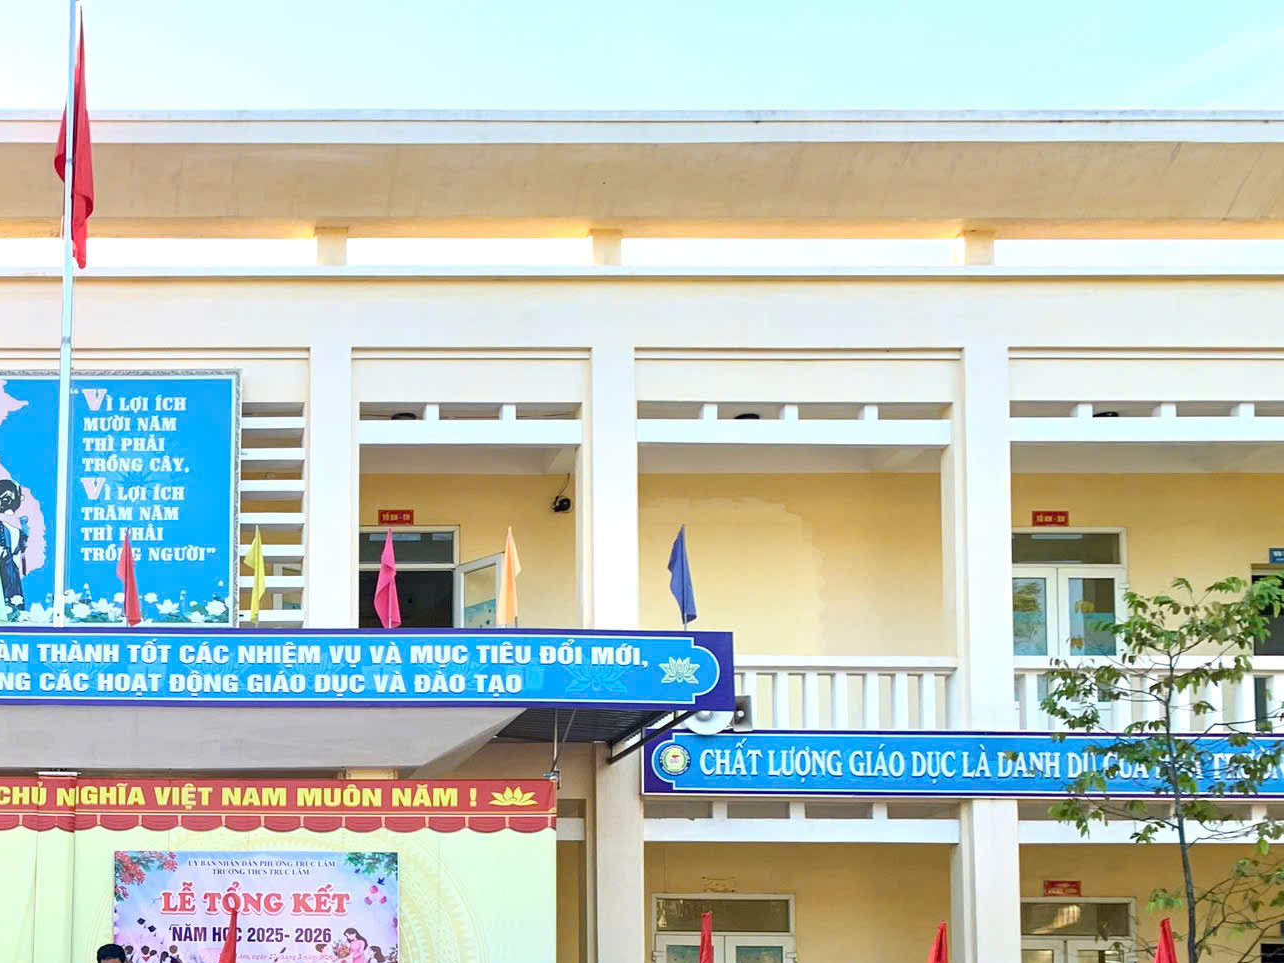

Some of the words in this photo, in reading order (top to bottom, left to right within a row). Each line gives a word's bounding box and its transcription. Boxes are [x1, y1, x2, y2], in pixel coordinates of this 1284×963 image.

[119, 395, 148, 413] LỢI
[155, 394, 186, 411] ÍCH
[83, 414, 131, 431] MƯỜI
[137, 415, 177, 431] NĂM
[82, 435, 114, 451] THÌ
[121, 434, 165, 451] PHẢI
[149, 455, 190, 472] CÂY,
[80, 477, 111, 500] VÌ
[117, 485, 147, 502] LỢI
[153, 483, 185, 500] ÍCH
[81, 504, 133, 520] TRĂM
[139, 504, 179, 520] NĂM
[81, 524, 113, 541] THÌ
[119, 523, 164, 541] PHẢI
[37, 641, 119, 662] THÀNH
[127, 638, 171, 664] TỐT
[179, 642, 229, 663] CÁC
[238, 642, 323, 667] NHIỆM
[329, 646, 361, 667] VỤ
[370, 642, 402, 664] VÀ
[410, 645, 468, 668] MỤC
[476, 641, 531, 664] TIÊU
[540, 639, 582, 665] ĐỔI
[591, 645, 648, 668] MỚI,
[39, 670, 89, 692] CÁC
[98, 674, 162, 696] HOẠT
[169, 670, 238, 696] ĐỘNG
[247, 672, 306, 693] GIÁO
[315, 674, 364, 697] DỤC
[373, 672, 406, 693] VÀ
[414, 671, 466, 693] ĐÀO
[473, 675, 523, 697] TẠO
[700, 739, 762, 775] CHẤT
[768, 747, 842, 782] LƯỢNG
[849, 744, 905, 777] GIÁO
[912, 751, 956, 784] DỤC
[962, 744, 992, 778] LÀ
[997, 751, 1061, 778] DANH
[56, 783, 146, 806] NGHĨA
[154, 783, 212, 809] VIỆT
[222, 787, 287, 806] NAM
[297, 784, 382, 807] MUÔN
[392, 784, 458, 807] NĂM
[469, 788, 477, 806] !
[162, 882, 196, 912] LỄ
[203, 881, 283, 913] TỔNG
[292, 884, 350, 913] KẾT
[172, 924, 207, 942] NĂM
[295, 928, 332, 943] 2026
